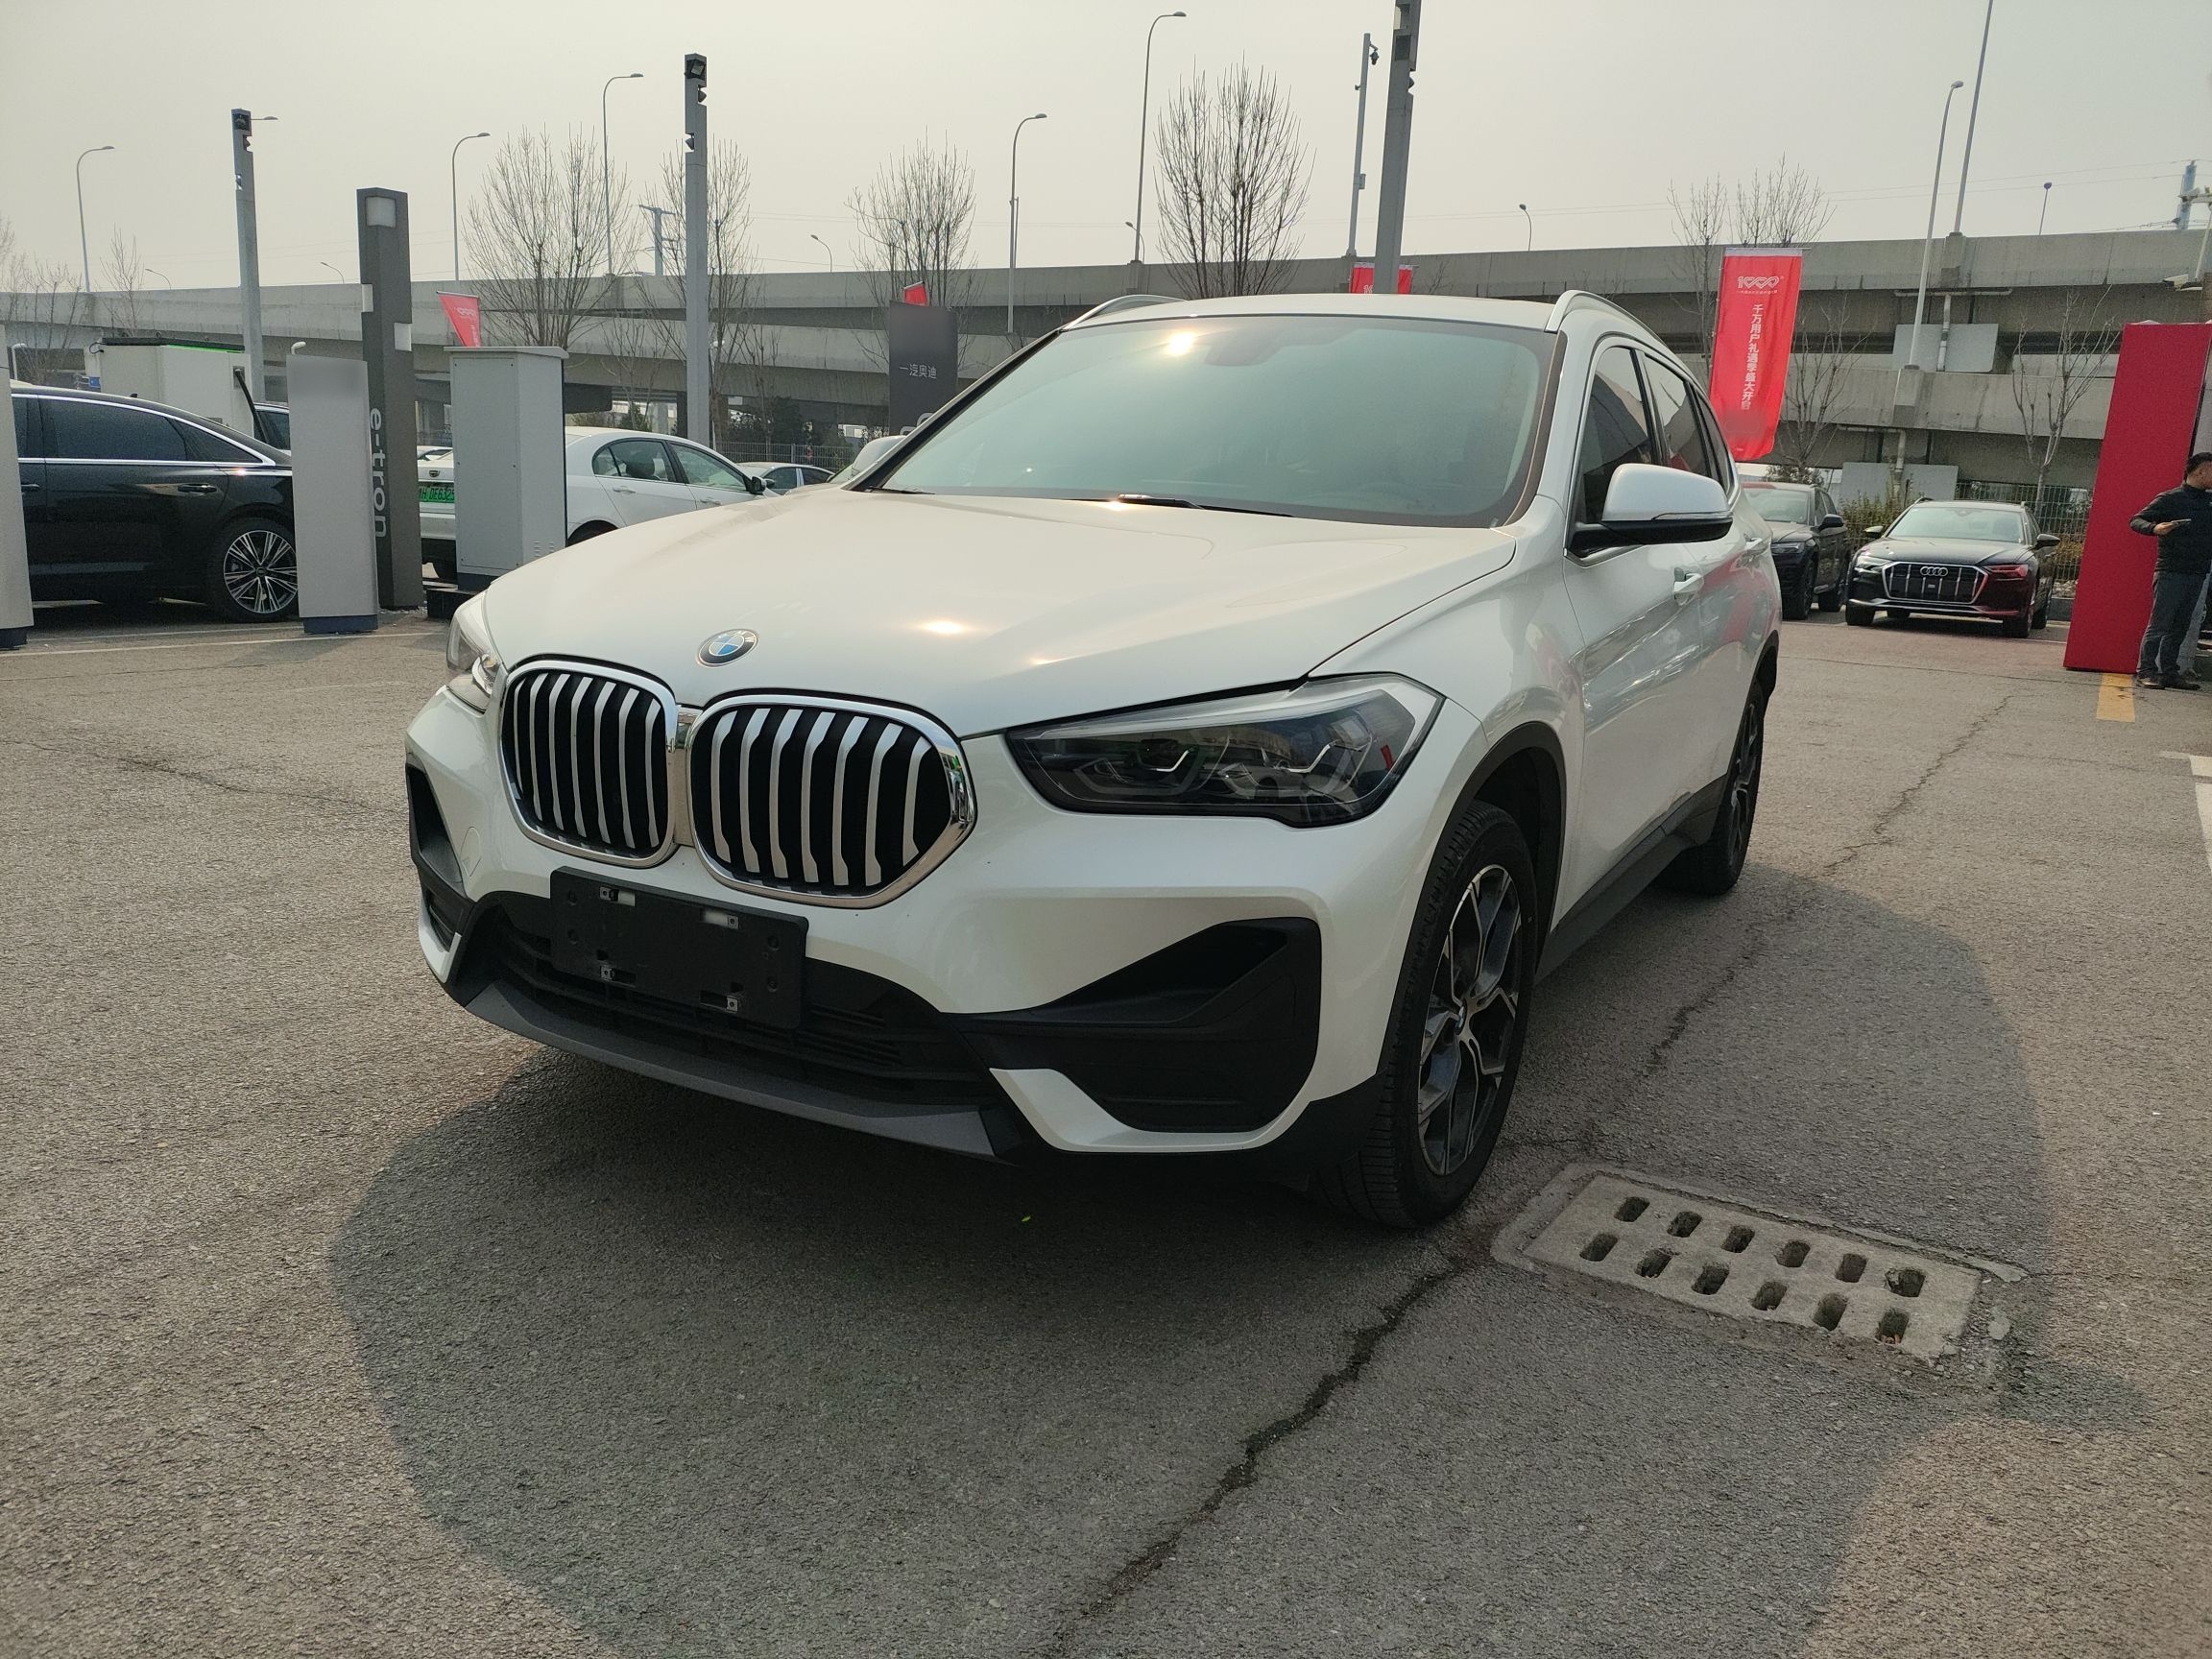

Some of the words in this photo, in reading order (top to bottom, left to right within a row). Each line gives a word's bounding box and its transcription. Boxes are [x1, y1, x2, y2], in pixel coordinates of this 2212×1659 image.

[899, 364, 937, 378] 一汽奥迪
[370, 408, 387, 538] e-tron
